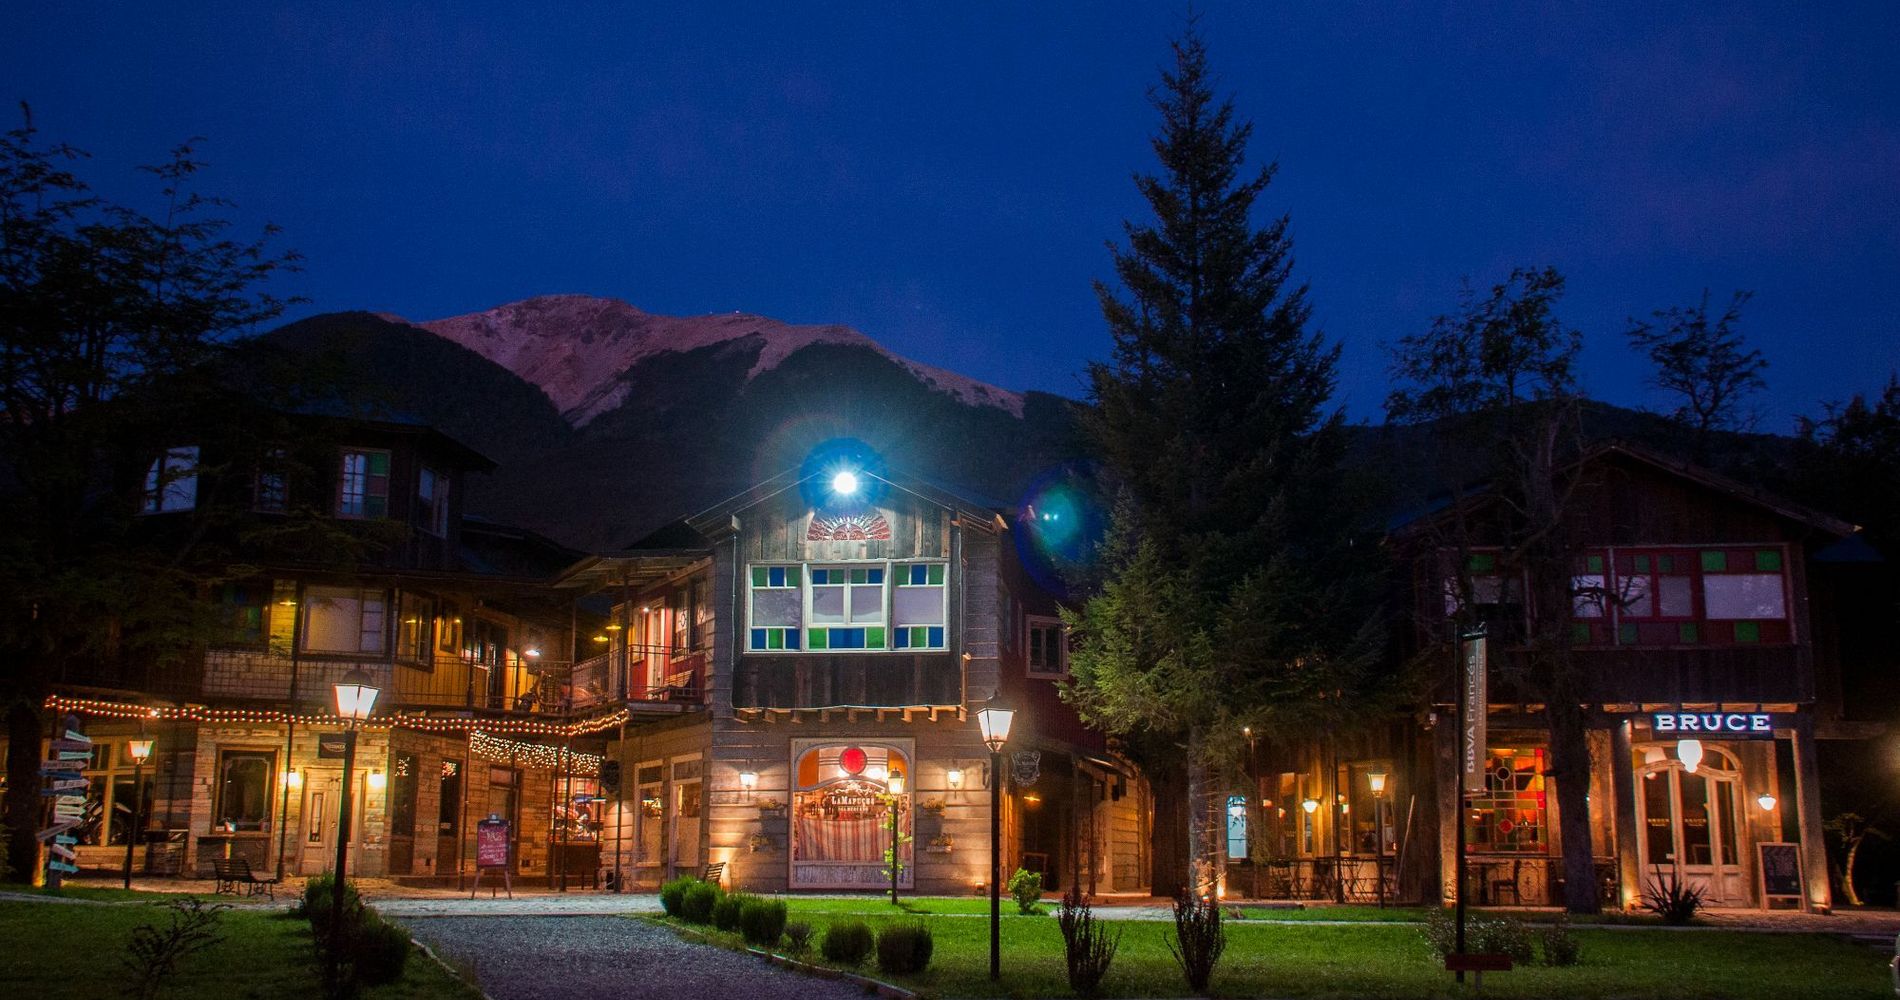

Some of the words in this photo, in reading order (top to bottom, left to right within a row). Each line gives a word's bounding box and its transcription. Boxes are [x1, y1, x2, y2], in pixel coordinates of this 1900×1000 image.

[1466, 655, 1476, 722] Francés
[1655, 714, 1771, 731] BRUCE
[1467, 726, 1476, 773] BBVA
